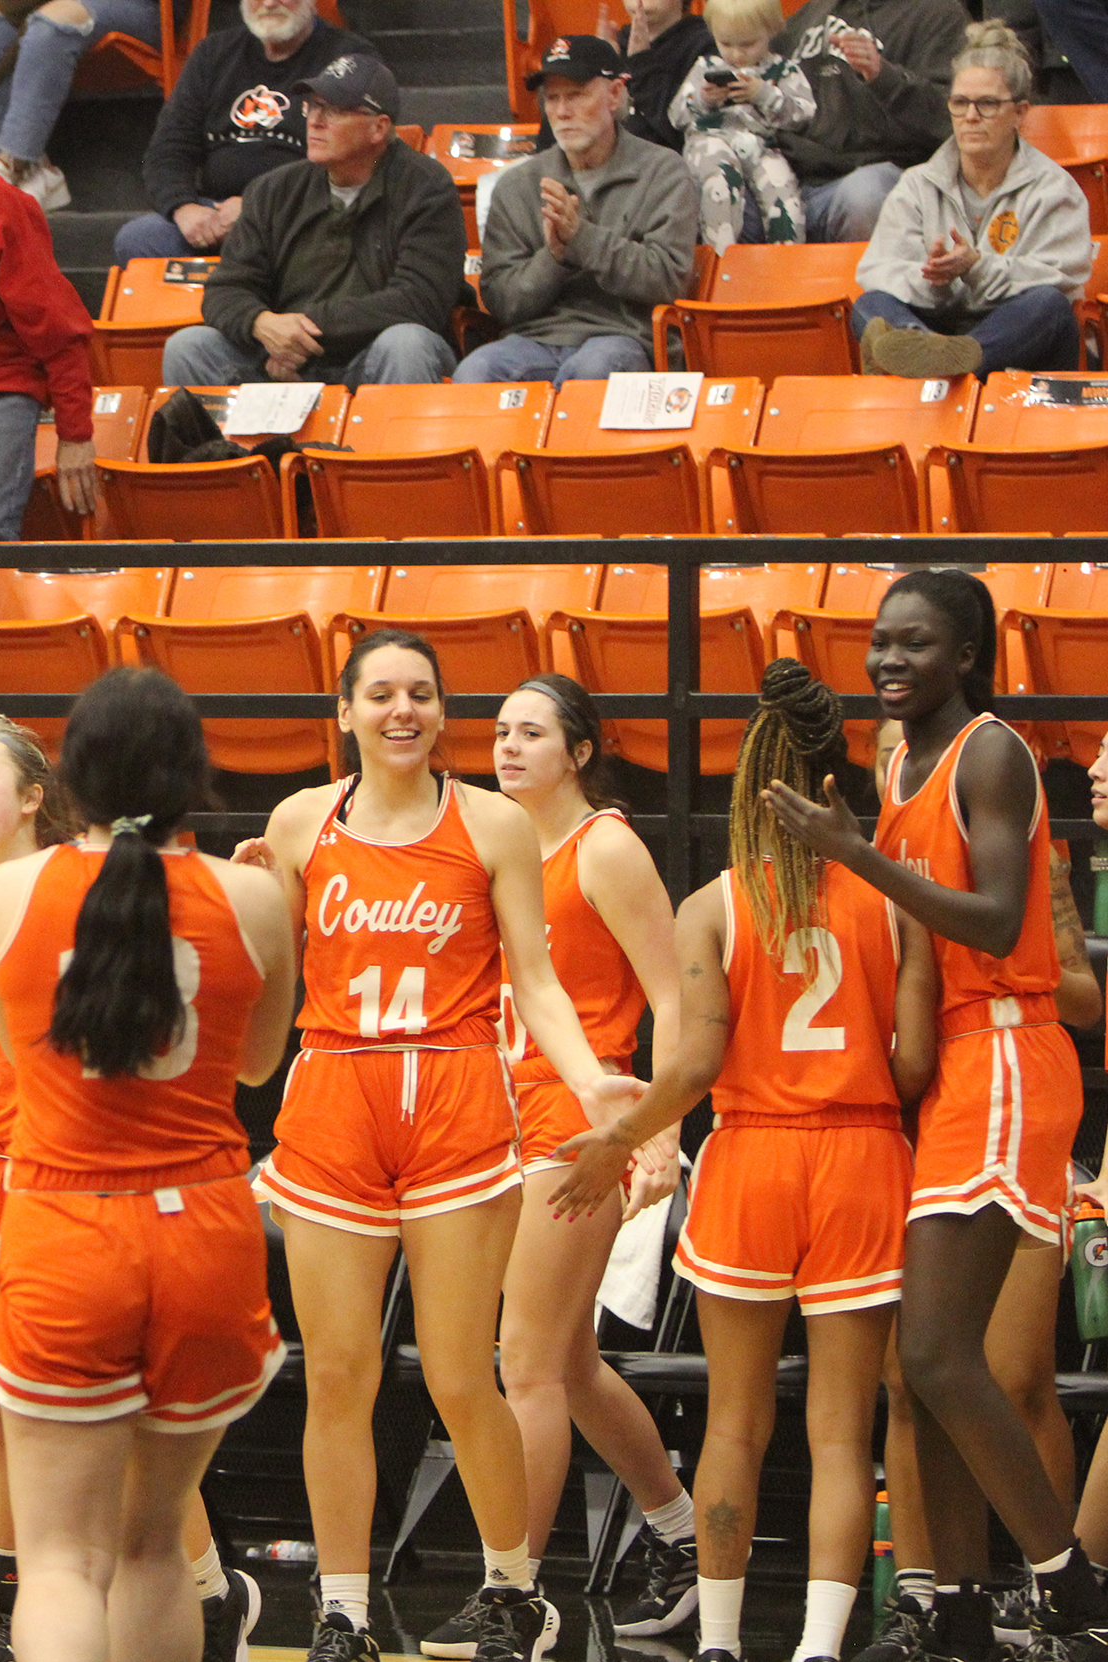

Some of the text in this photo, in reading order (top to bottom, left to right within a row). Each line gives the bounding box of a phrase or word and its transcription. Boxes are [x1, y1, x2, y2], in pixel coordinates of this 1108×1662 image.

[318, 874, 463, 955] Cowley
[348, 965, 428, 1039] 14
[781, 926, 846, 1052] 2
